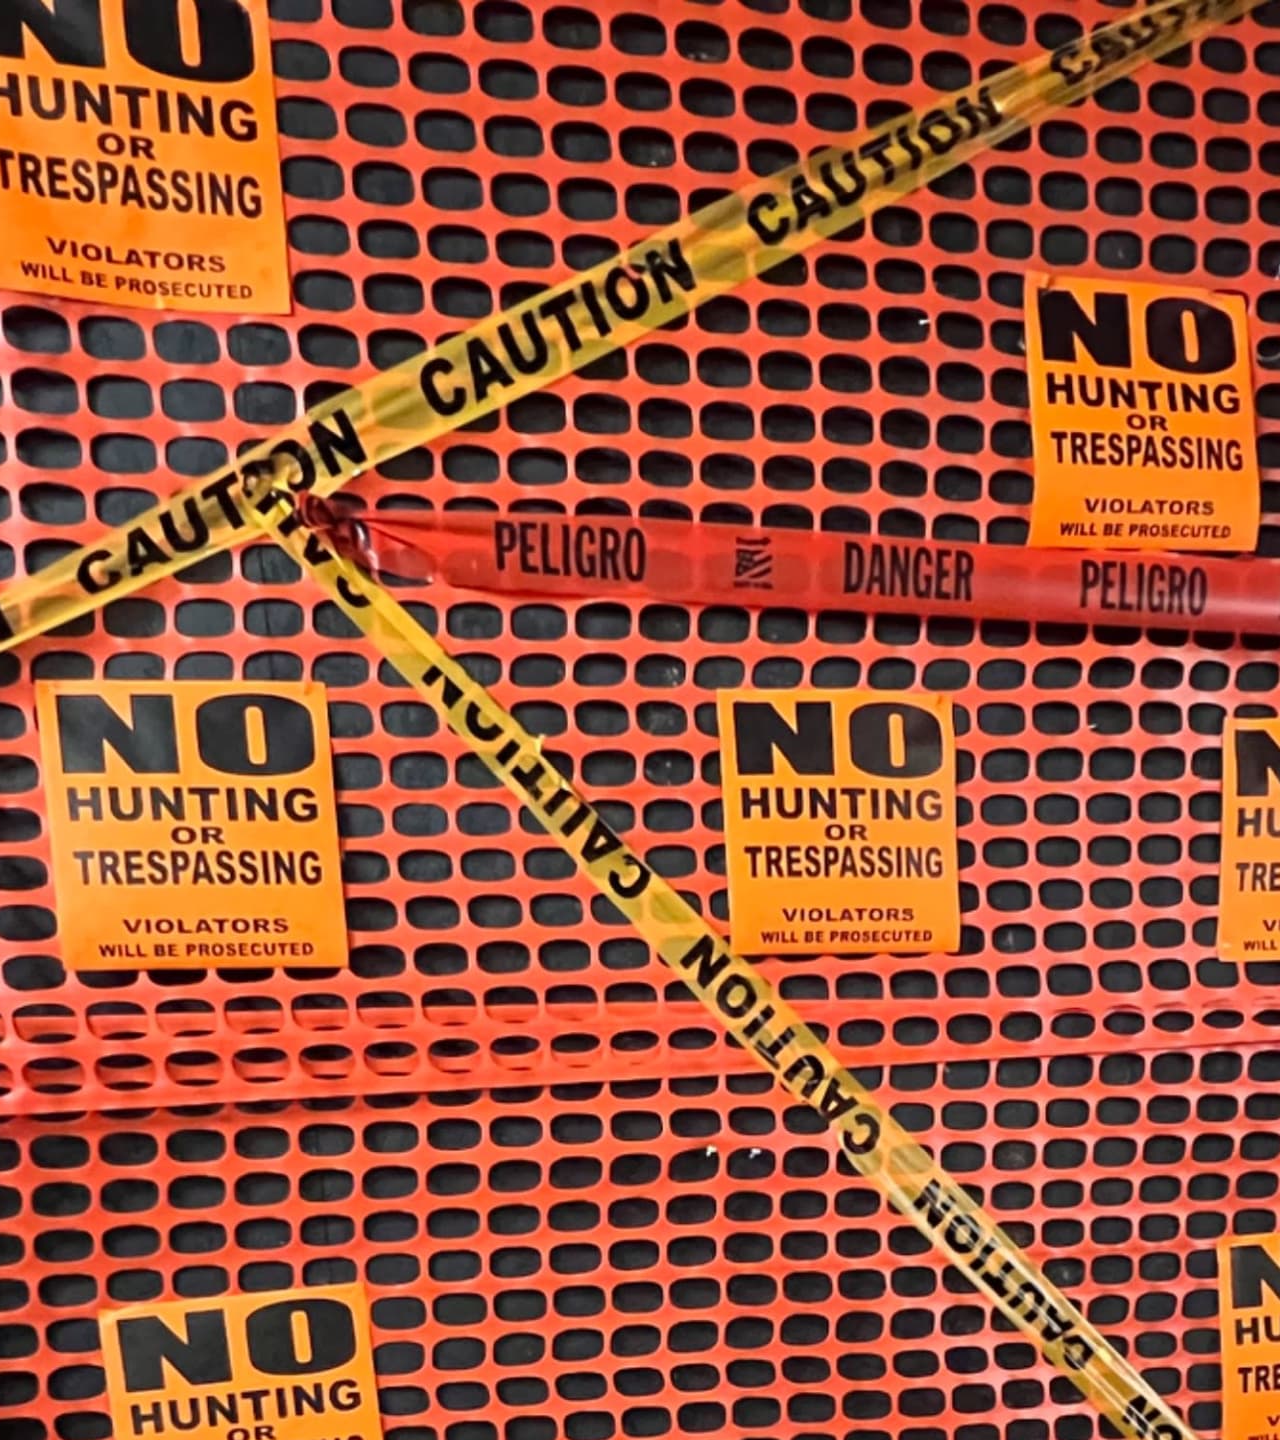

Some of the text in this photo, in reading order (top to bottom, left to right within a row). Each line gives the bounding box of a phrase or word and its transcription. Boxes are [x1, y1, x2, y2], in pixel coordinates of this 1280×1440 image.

[97, 132, 155, 159] OR
[47, 237, 225, 272] VIOLATORS
[420, 236, 696, 417] CAUTION
[746, 86, 1003, 246] CAUTION
[21, 262, 252, 298] WILL BE PROSECUTED
[1037, 288, 1236, 374] NO
[1046, 372, 1240, 414] HUNTING
[1127, 414, 1168, 431] OR
[1051, 432, 1243, 471] TRESPASSING
[1085, 498, 1214, 515] VIOLATORS
[1060, 523, 1231, 538] WILL BE PROSECUTED
[494, 521, 647, 582] PELIGRO
[844, 541, 975, 601] DANGER
[1079, 560, 1208, 616] PELIGRO
[56, 693, 315, 775] NO
[733, 701, 943, 778] NO
[67, 787, 318, 822] HUNTING
[741, 788, 942, 820] HUNTING
[171, 826, 224, 844] OR
[825, 824, 867, 840] OR
[73, 850, 321, 885] TRESPASSING
[745, 846, 942, 878] TRESPASSING
[123, 918, 289, 933] VIOLATORS
[783, 908, 914, 921] VIOLATORS
[99, 943, 313, 957] WILL BE PROSECUTED
[761, 930, 932, 943] WILL BE PROSECUTED
[1243, 940, 1277, 951] WILL
[680, 933, 881, 1155] CAUTION
[914, 1178, 1096, 1371] CAUTION
[117, 1299, 356, 1392] NO
[131, 1380, 361, 1435] HUNTING
